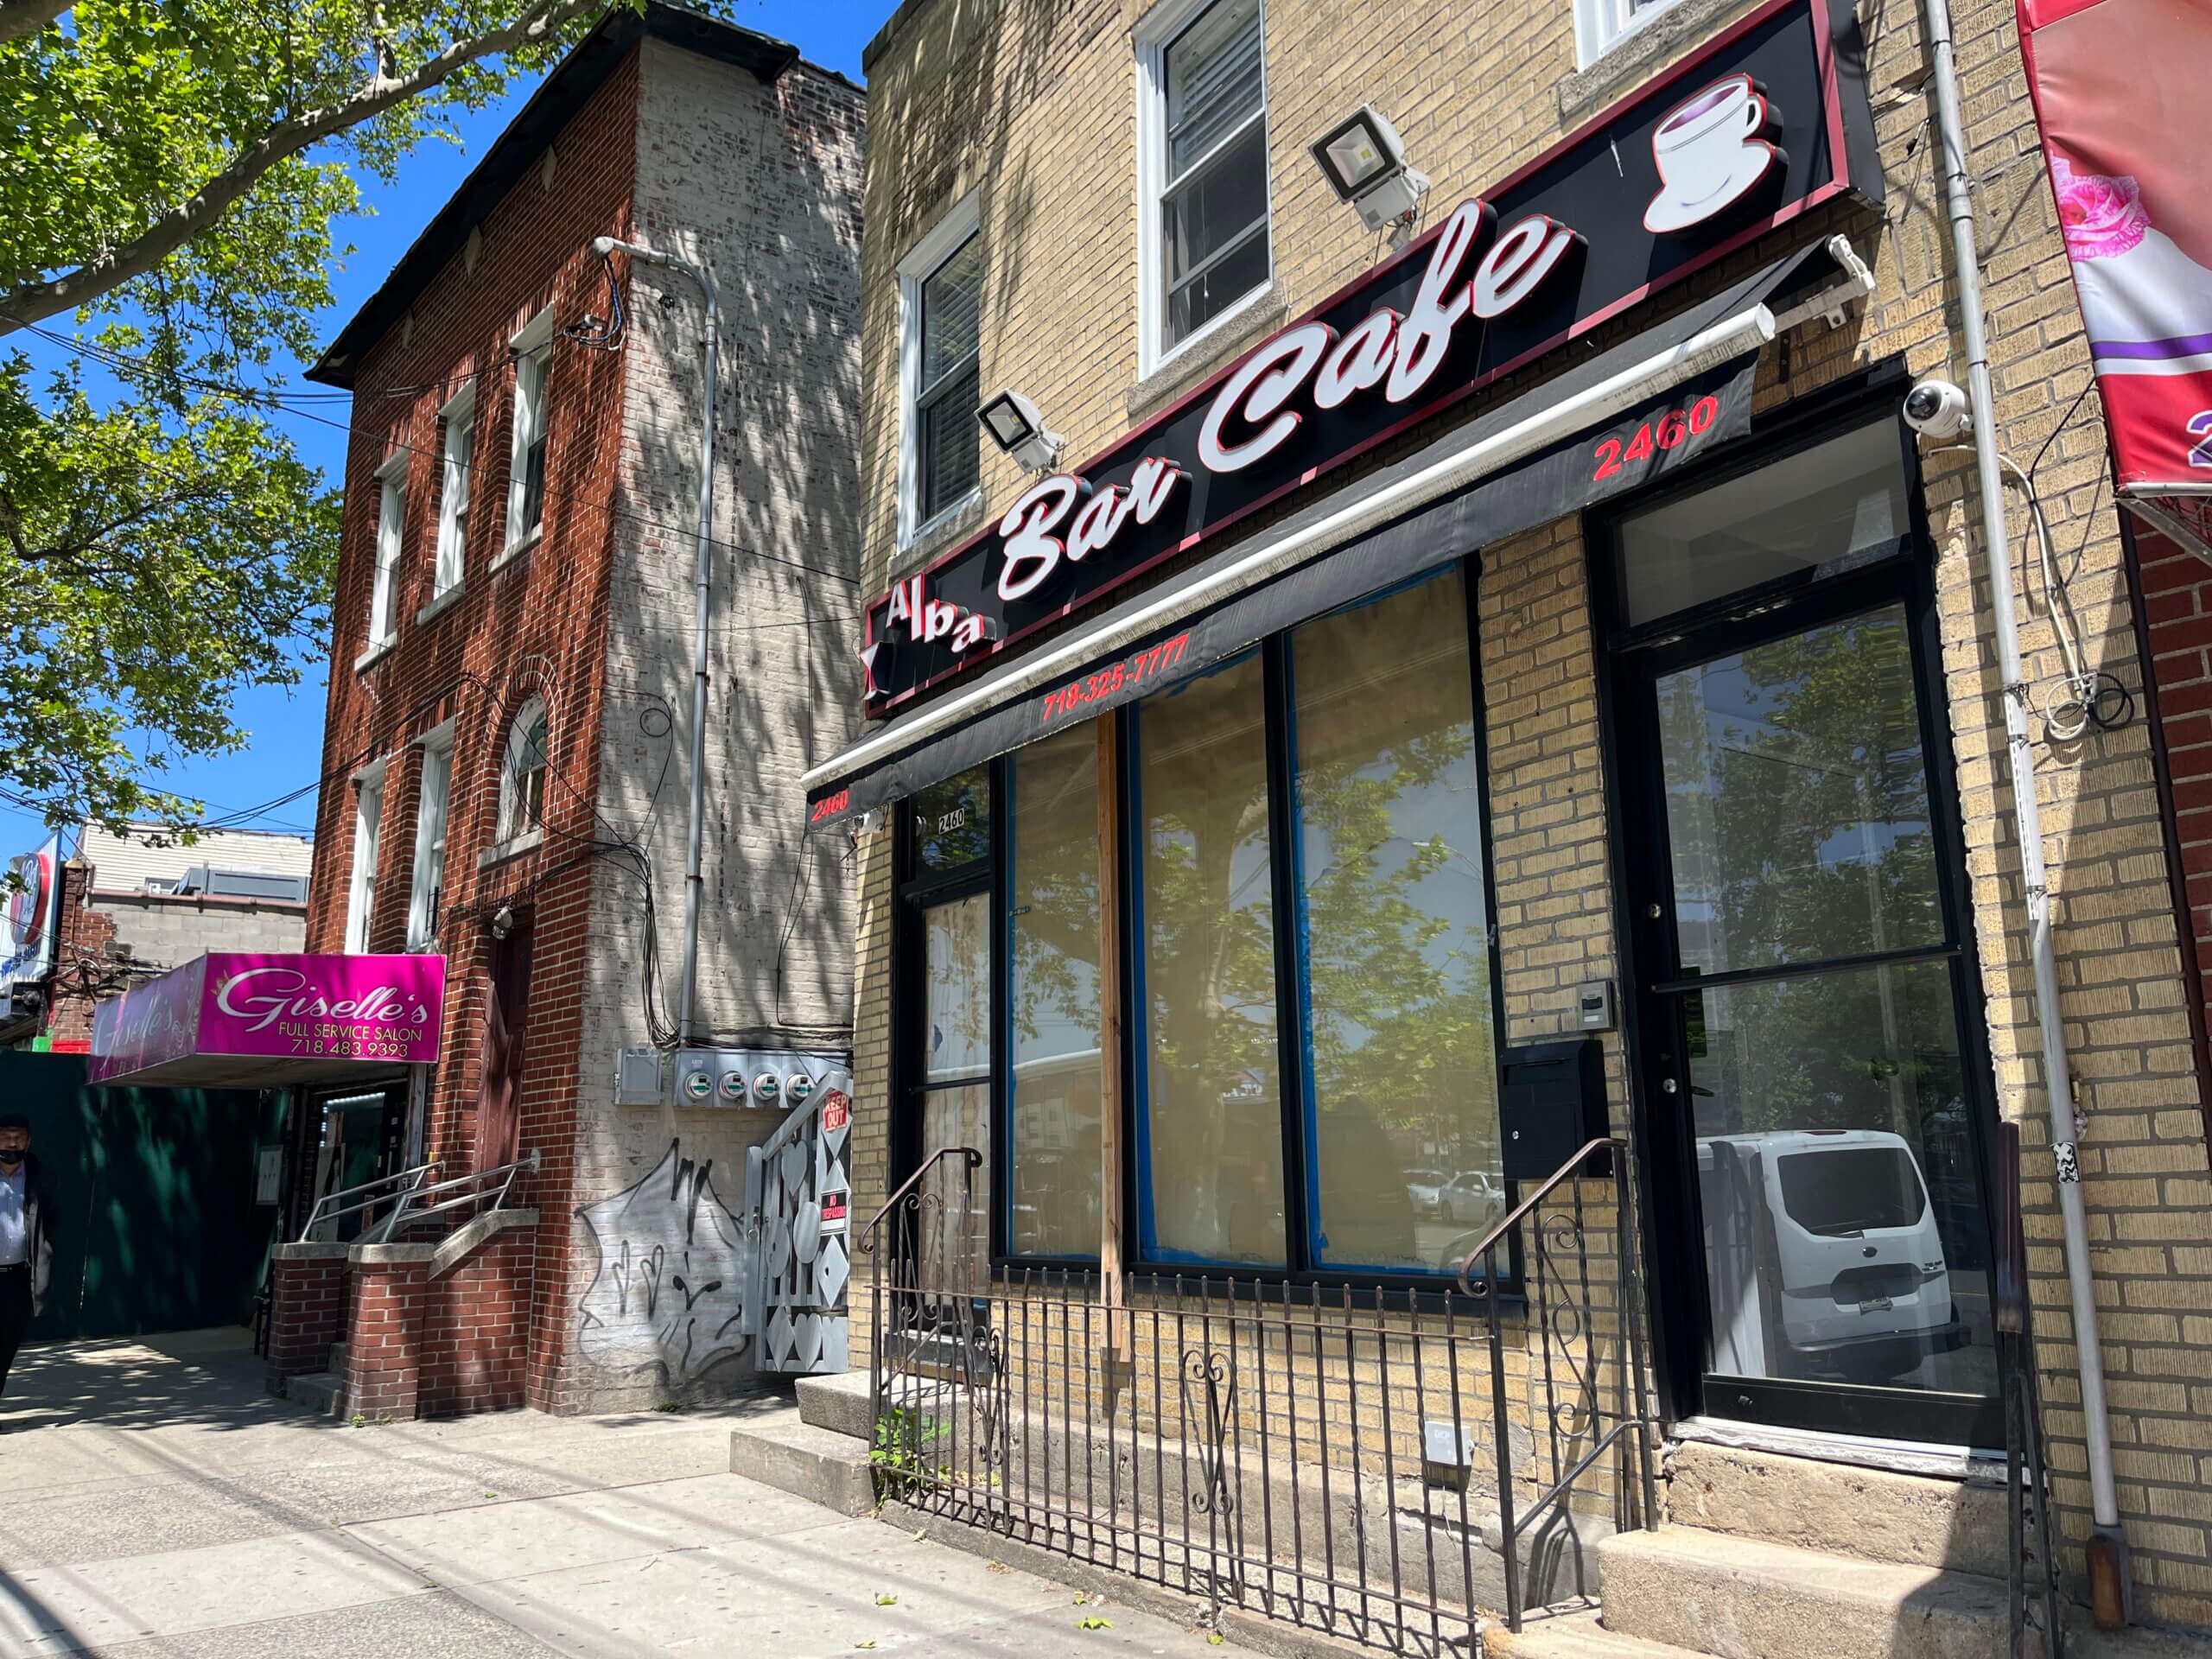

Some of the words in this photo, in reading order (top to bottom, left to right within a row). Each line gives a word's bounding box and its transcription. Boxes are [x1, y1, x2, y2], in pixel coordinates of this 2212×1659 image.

[886, 573, 986, 653] Alba
[997, 457, 1181, 601] Bar
[1198, 198, 1574, 474] Cafe
[1592, 395, 1719, 482] 2460
[1043, 632, 1190, 721] 718-325-7777
[811, 788, 849, 823] 2460
[939, 808, 964, 835] 2460
[217, 968, 429, 1033] Giselle's
[279, 1022, 309, 1037] FULL
[314, 1024, 370, 1040] SERVICE
[374, 1026, 423, 1042] SALON
[290, 1039, 409, 1058] 718.483.9393
[824, 1095, 847, 1113] KEEP
[828, 1110, 843, 1127] OUT
